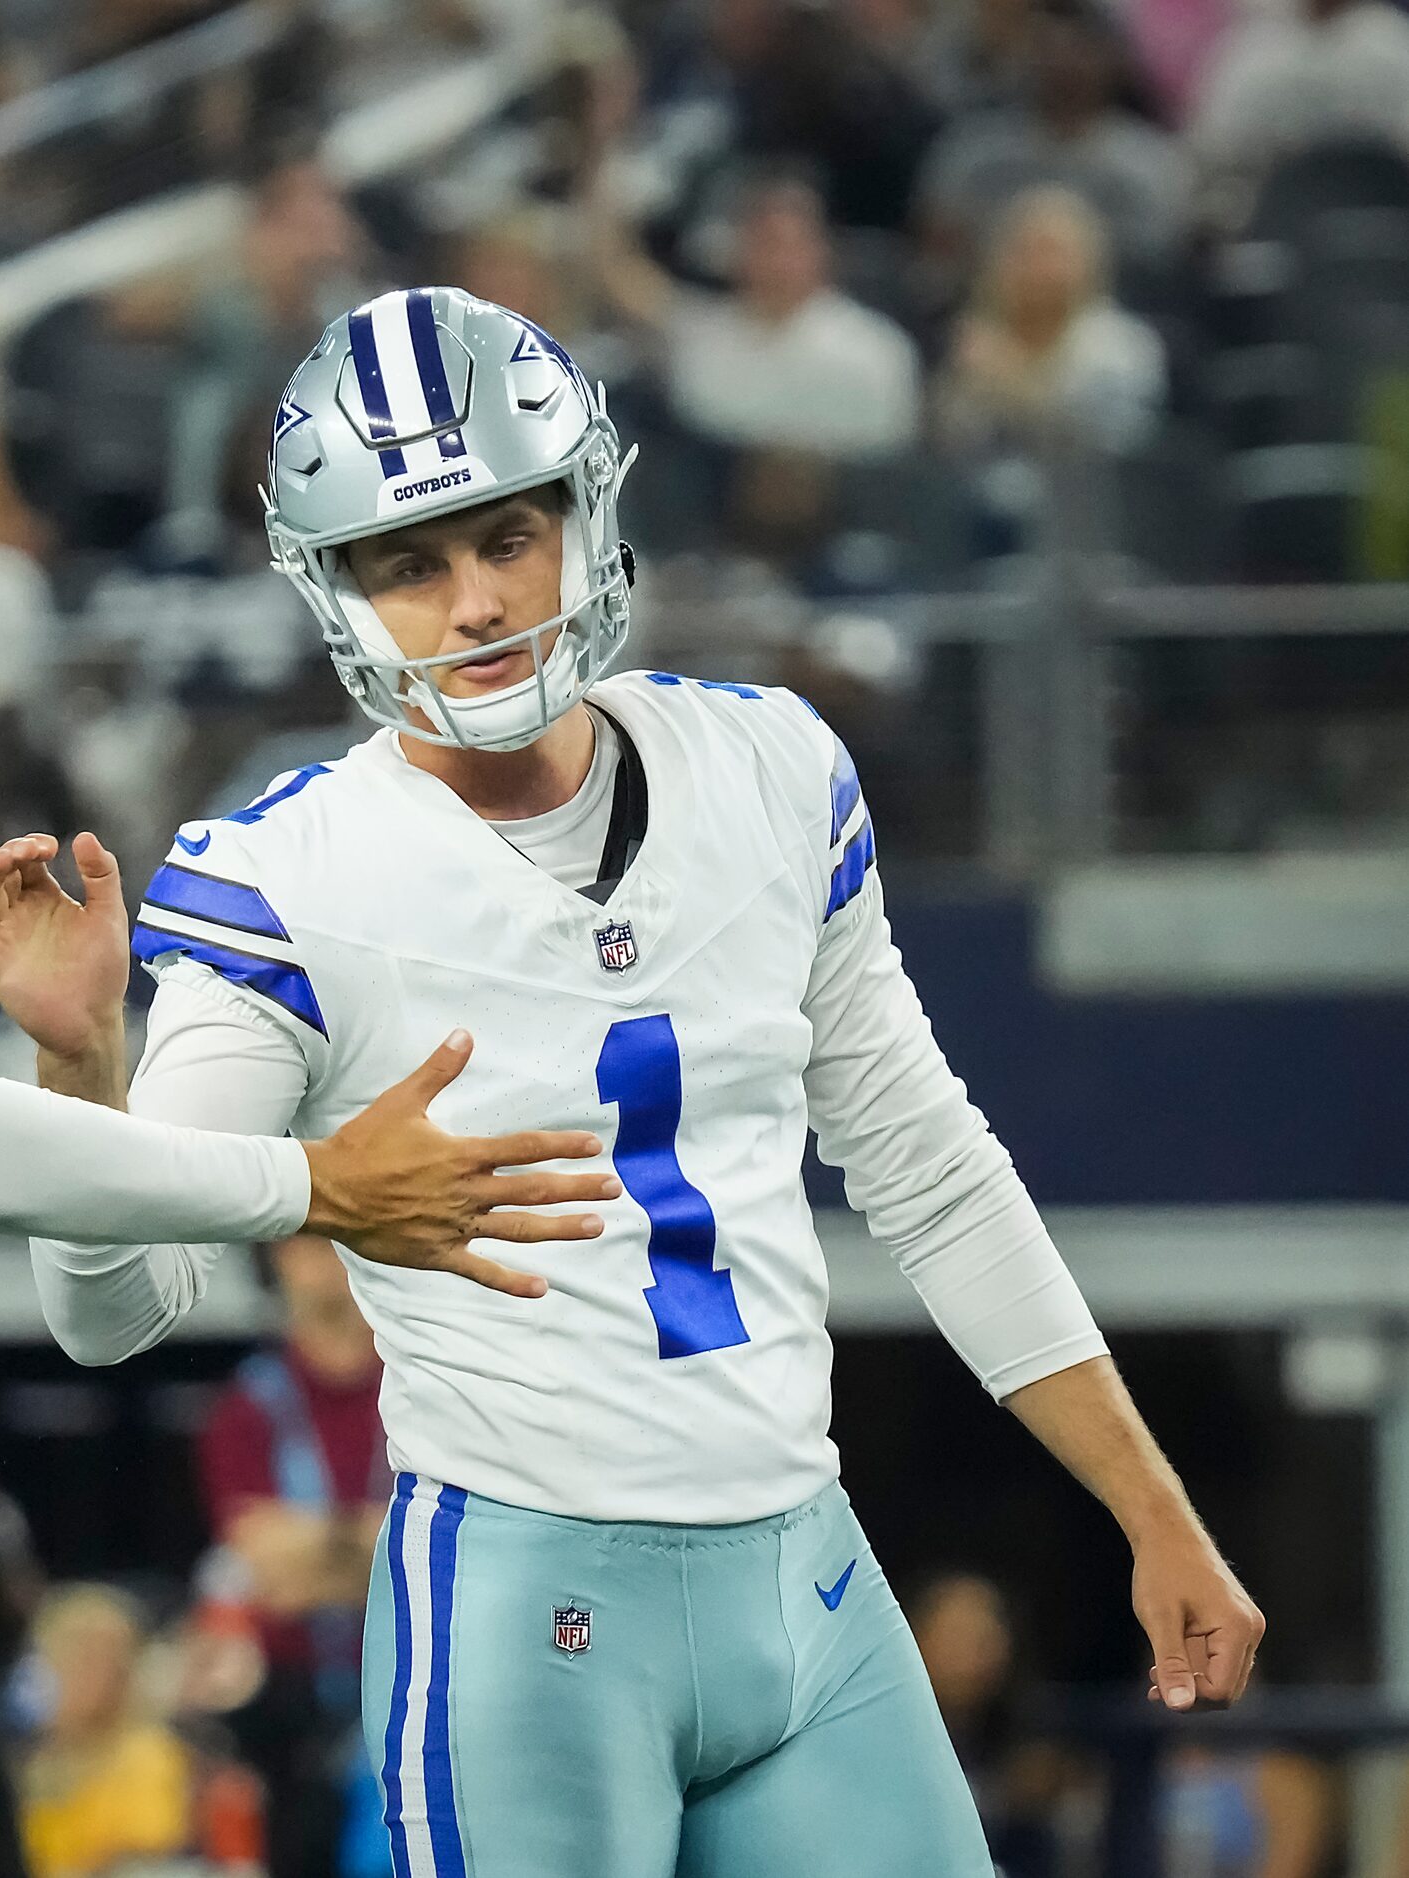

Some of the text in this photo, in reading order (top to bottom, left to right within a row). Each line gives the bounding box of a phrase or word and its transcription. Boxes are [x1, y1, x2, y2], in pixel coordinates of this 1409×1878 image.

[394, 468, 471, 501] COWBOYS
[604, 942, 634, 966] NFL
[596, 1013, 751, 1360] 1
[557, 1626, 587, 1649] NFL
